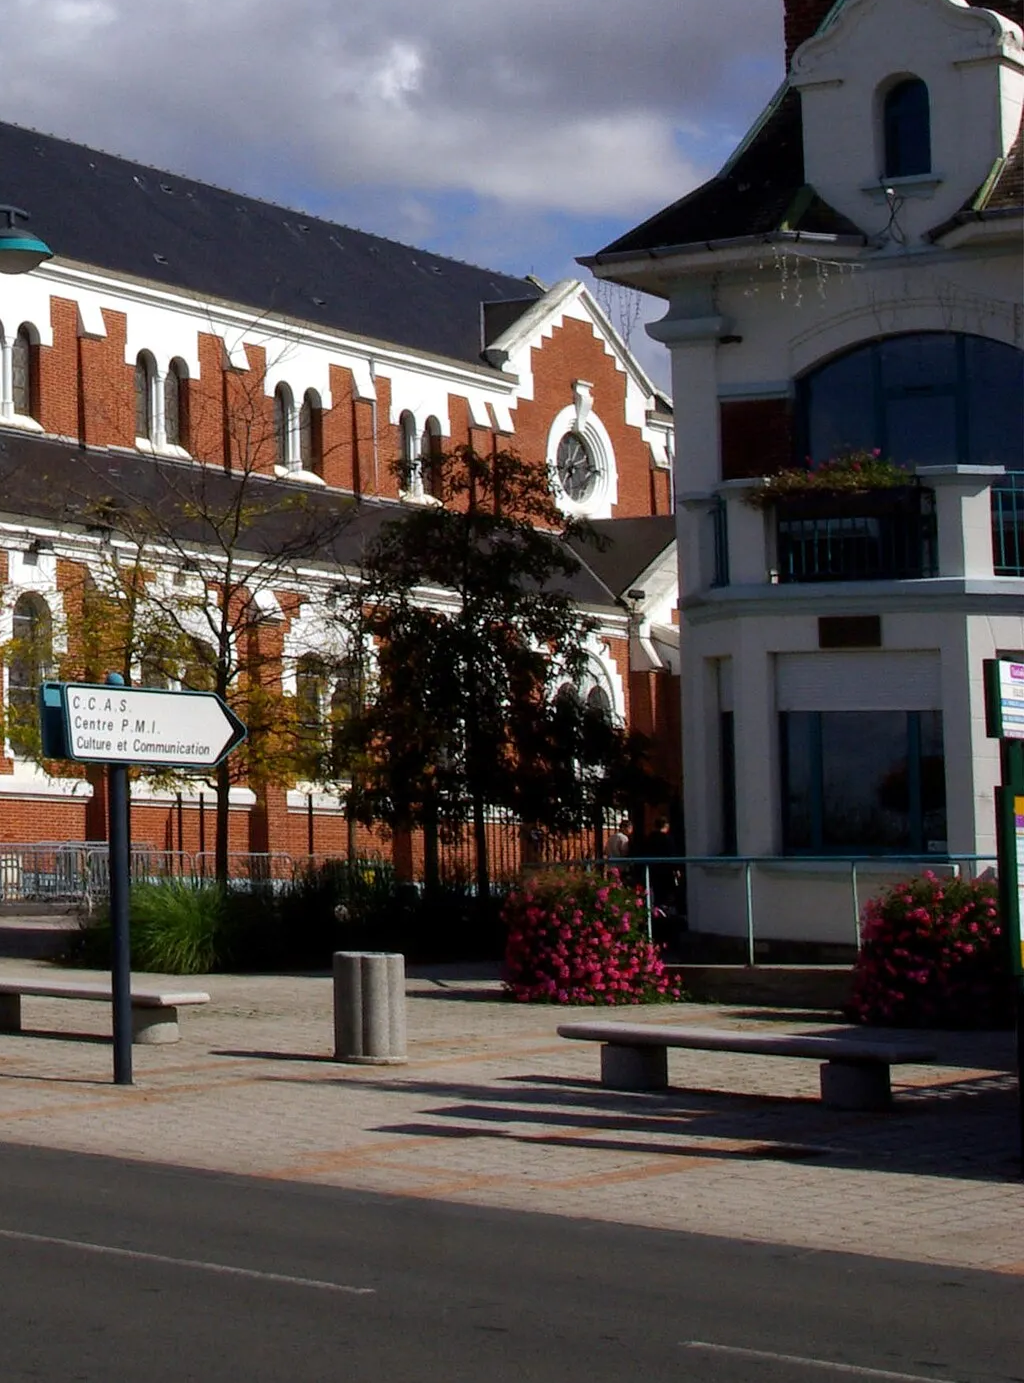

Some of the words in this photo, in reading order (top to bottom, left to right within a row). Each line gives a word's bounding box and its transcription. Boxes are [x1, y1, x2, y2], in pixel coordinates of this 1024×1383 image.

[75, 716, 114, 731] Centre
[121, 719, 161, 734] P.M.I.
[77, 736, 111, 751] Culture
[117, 741, 127, 751] et
[133, 739, 210, 755] Communication
